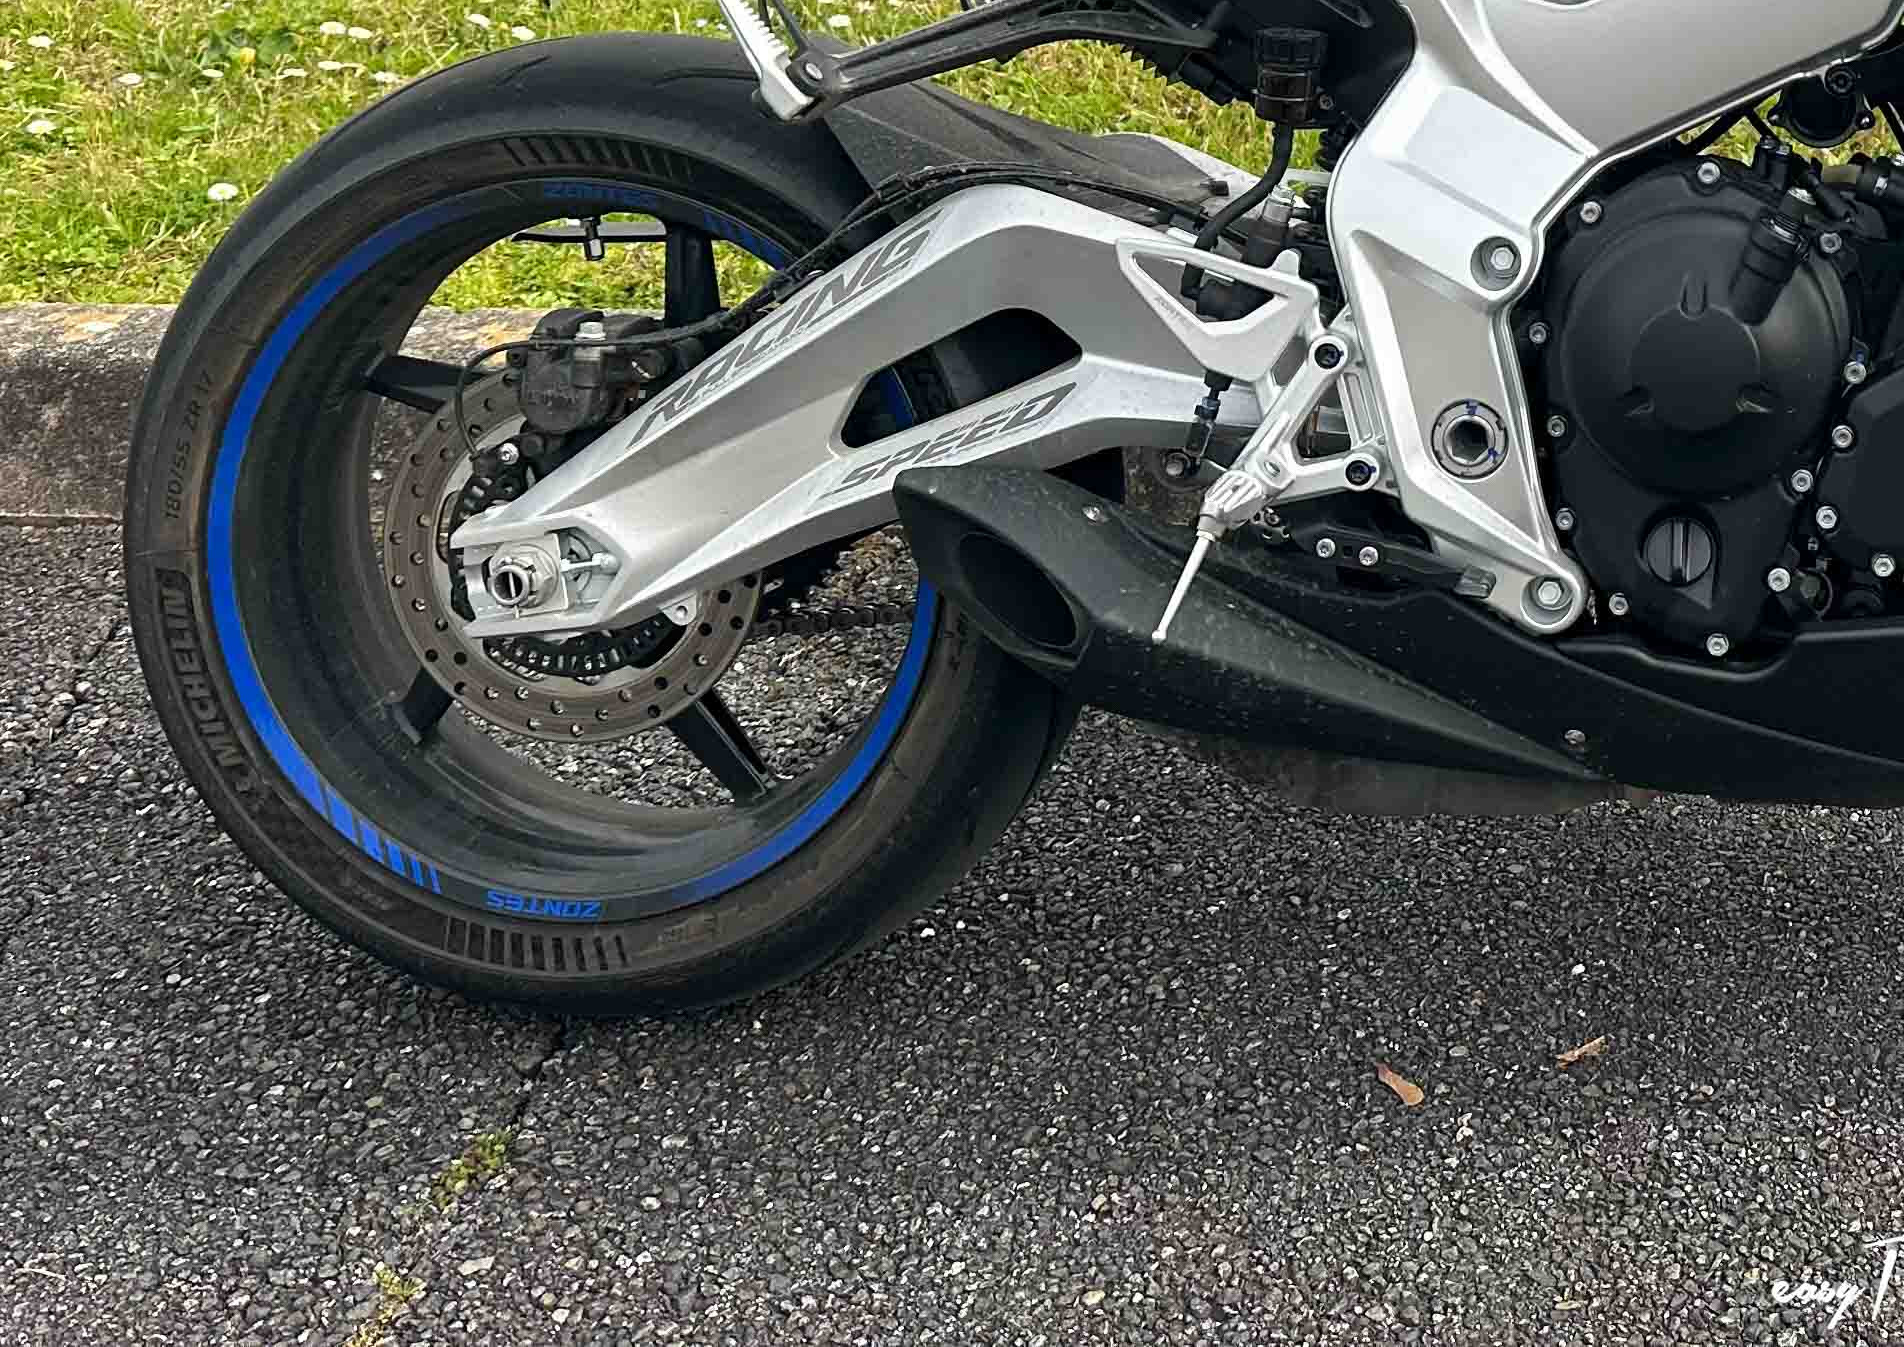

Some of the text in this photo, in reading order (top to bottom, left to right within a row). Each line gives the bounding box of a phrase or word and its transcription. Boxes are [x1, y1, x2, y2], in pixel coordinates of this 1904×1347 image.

[624, 206, 945, 452] RACING
[817, 381, 1077, 501] SPEED
[161, 586, 243, 768] MICHELIN
[486, 889, 602, 919] ZONTES
